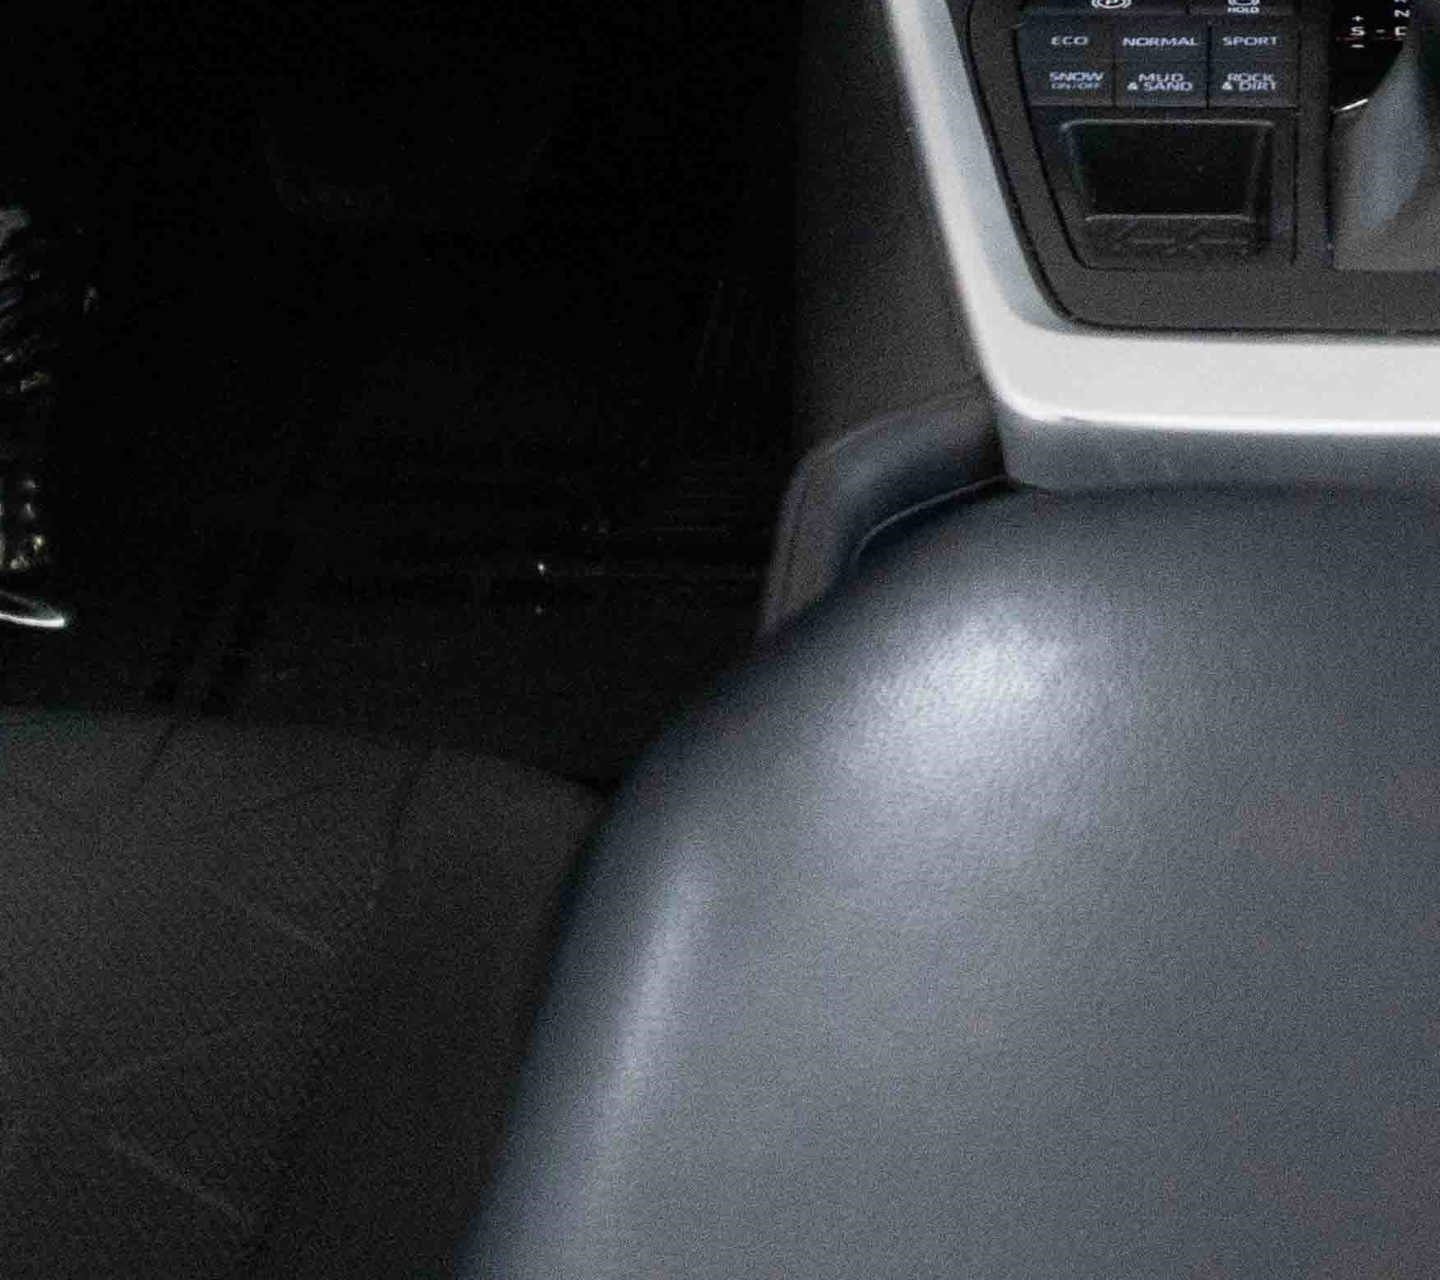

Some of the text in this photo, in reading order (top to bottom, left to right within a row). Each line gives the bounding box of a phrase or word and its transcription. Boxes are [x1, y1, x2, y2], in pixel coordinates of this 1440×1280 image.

[1227, 6, 1260, 14] HOLD
[1050, 35, 1089, 46] ECO
[1121, 36, 1199, 47] NORMAL
[1221, 35, 1278, 46] SPORT
[1049, 71, 1105, 82] SNOW
[1138, 72, 1184, 82] MUD
[1227, 72, 1276, 82] ROCK
[1143, 81, 1193, 91] SAND
[1238, 81, 1278, 91] DIRT
